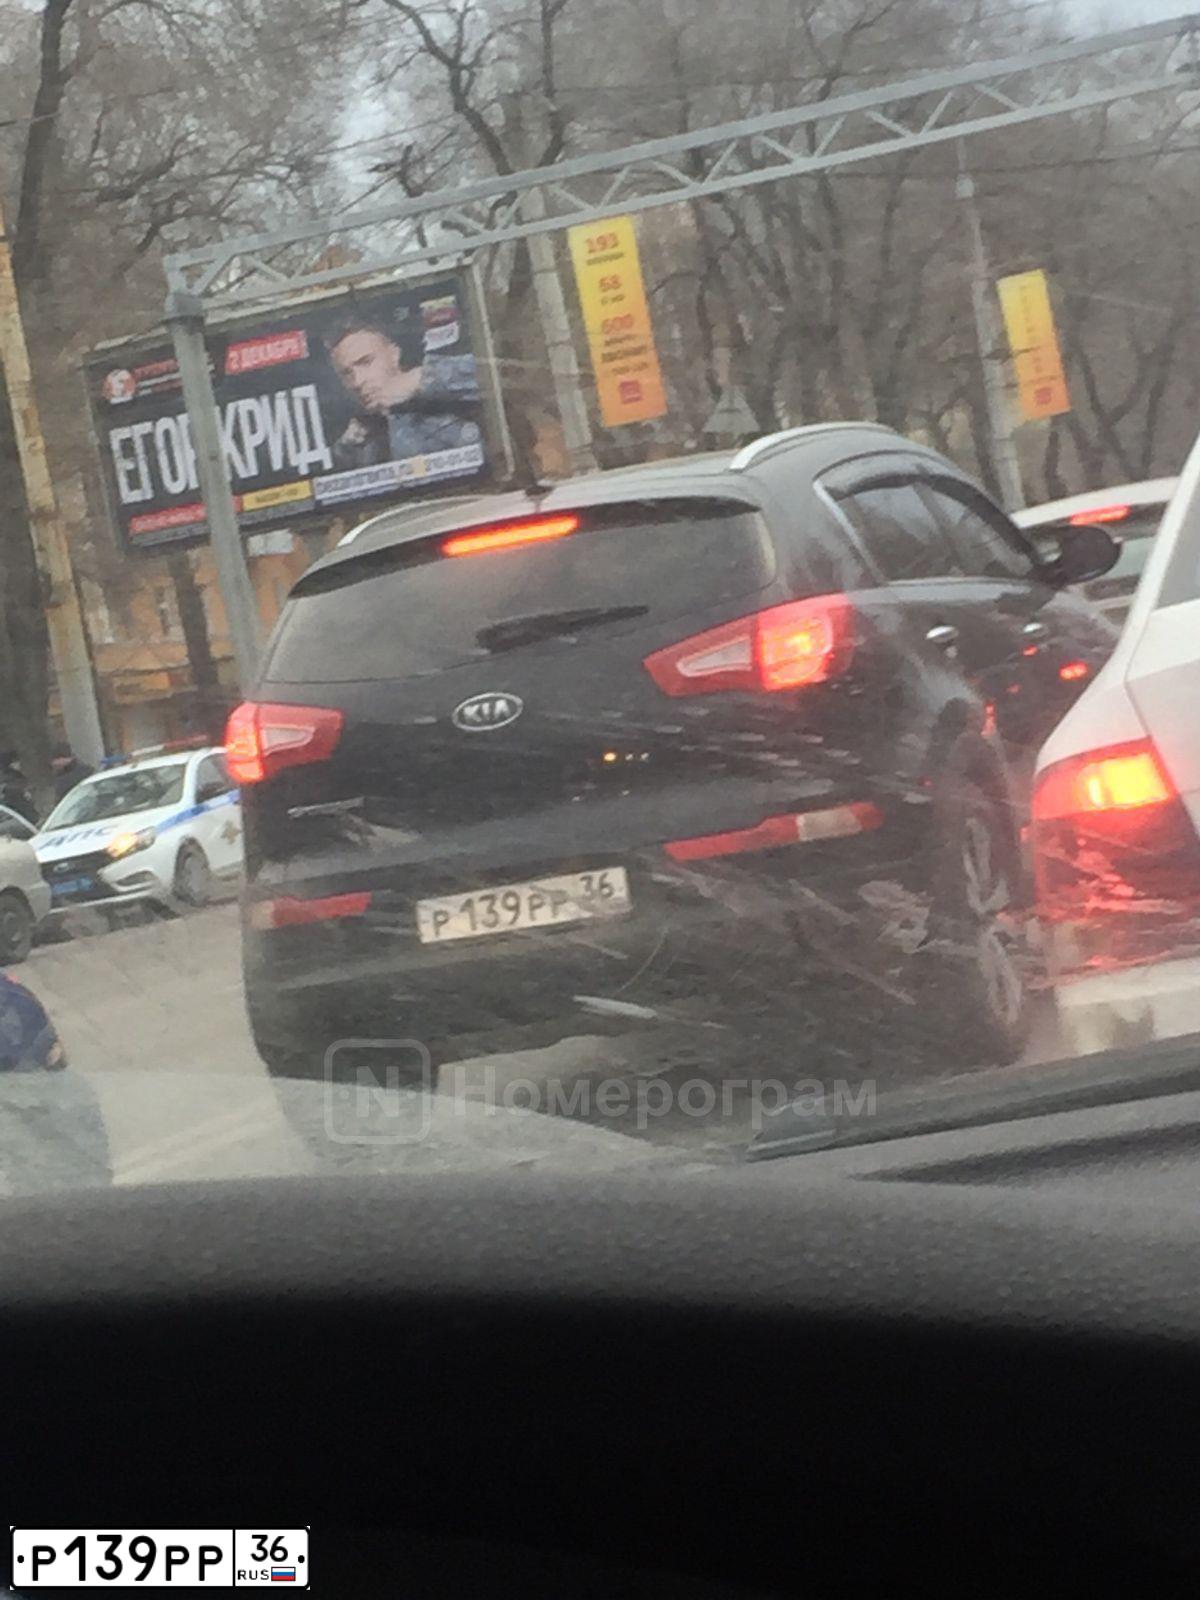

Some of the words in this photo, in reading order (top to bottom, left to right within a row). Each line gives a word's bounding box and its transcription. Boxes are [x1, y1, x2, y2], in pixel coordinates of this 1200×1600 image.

[214, 384, 333, 479] КРИД
[462, 698, 512, 723] KIA
[579, 872, 615, 899] 36
